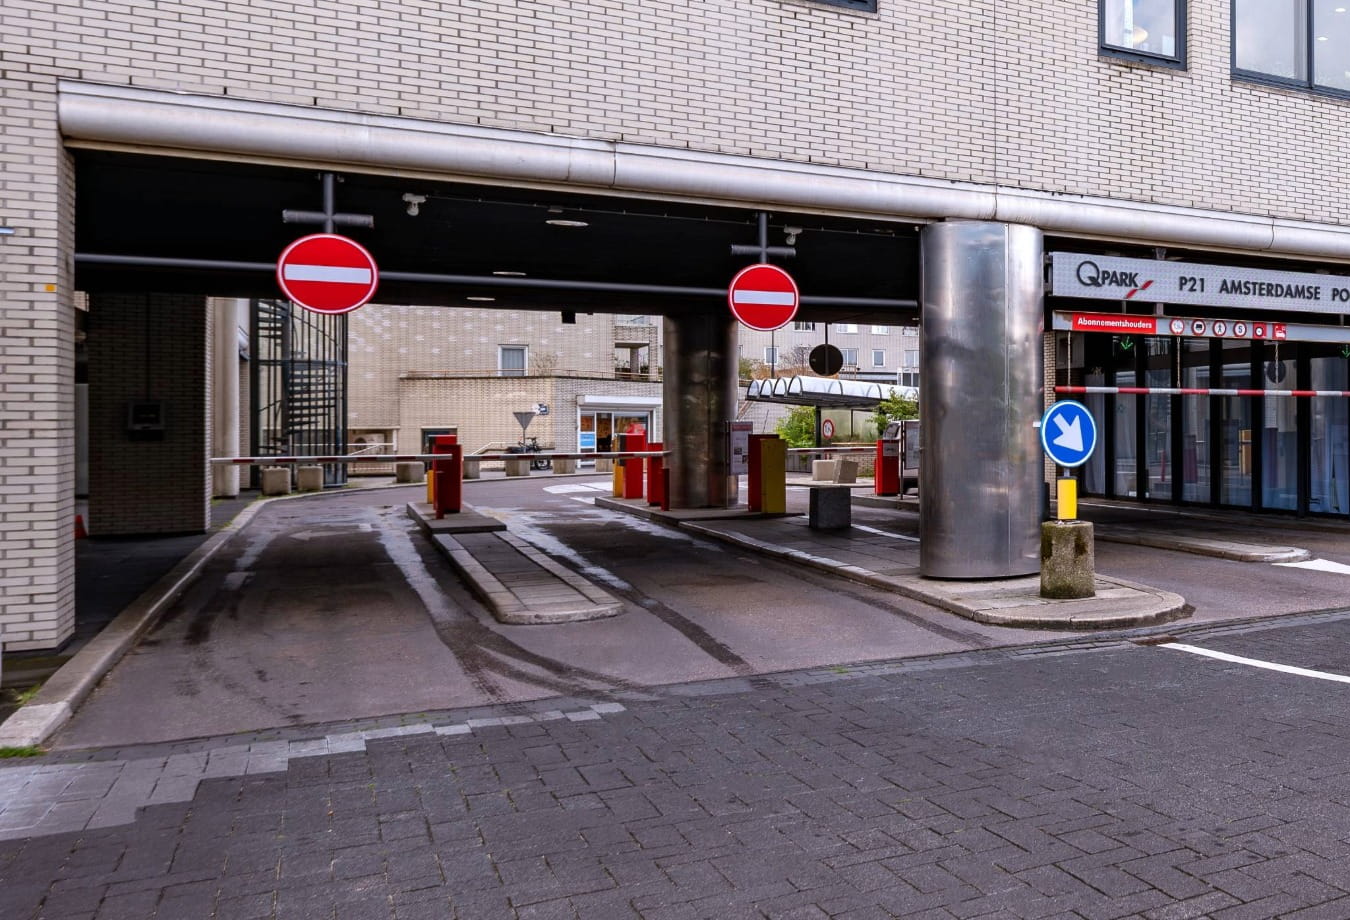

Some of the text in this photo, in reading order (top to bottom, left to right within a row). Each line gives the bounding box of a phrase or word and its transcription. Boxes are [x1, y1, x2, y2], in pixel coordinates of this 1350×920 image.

[1076, 260, 1139, 288] QPARK
[1179, 276, 1205, 293] P21
[1219, 278, 1321, 300] AMSTERDAMSE
[1077, 316, 1153, 330] Abonnementshouders
[1237, 325, 1243, 334] 5
